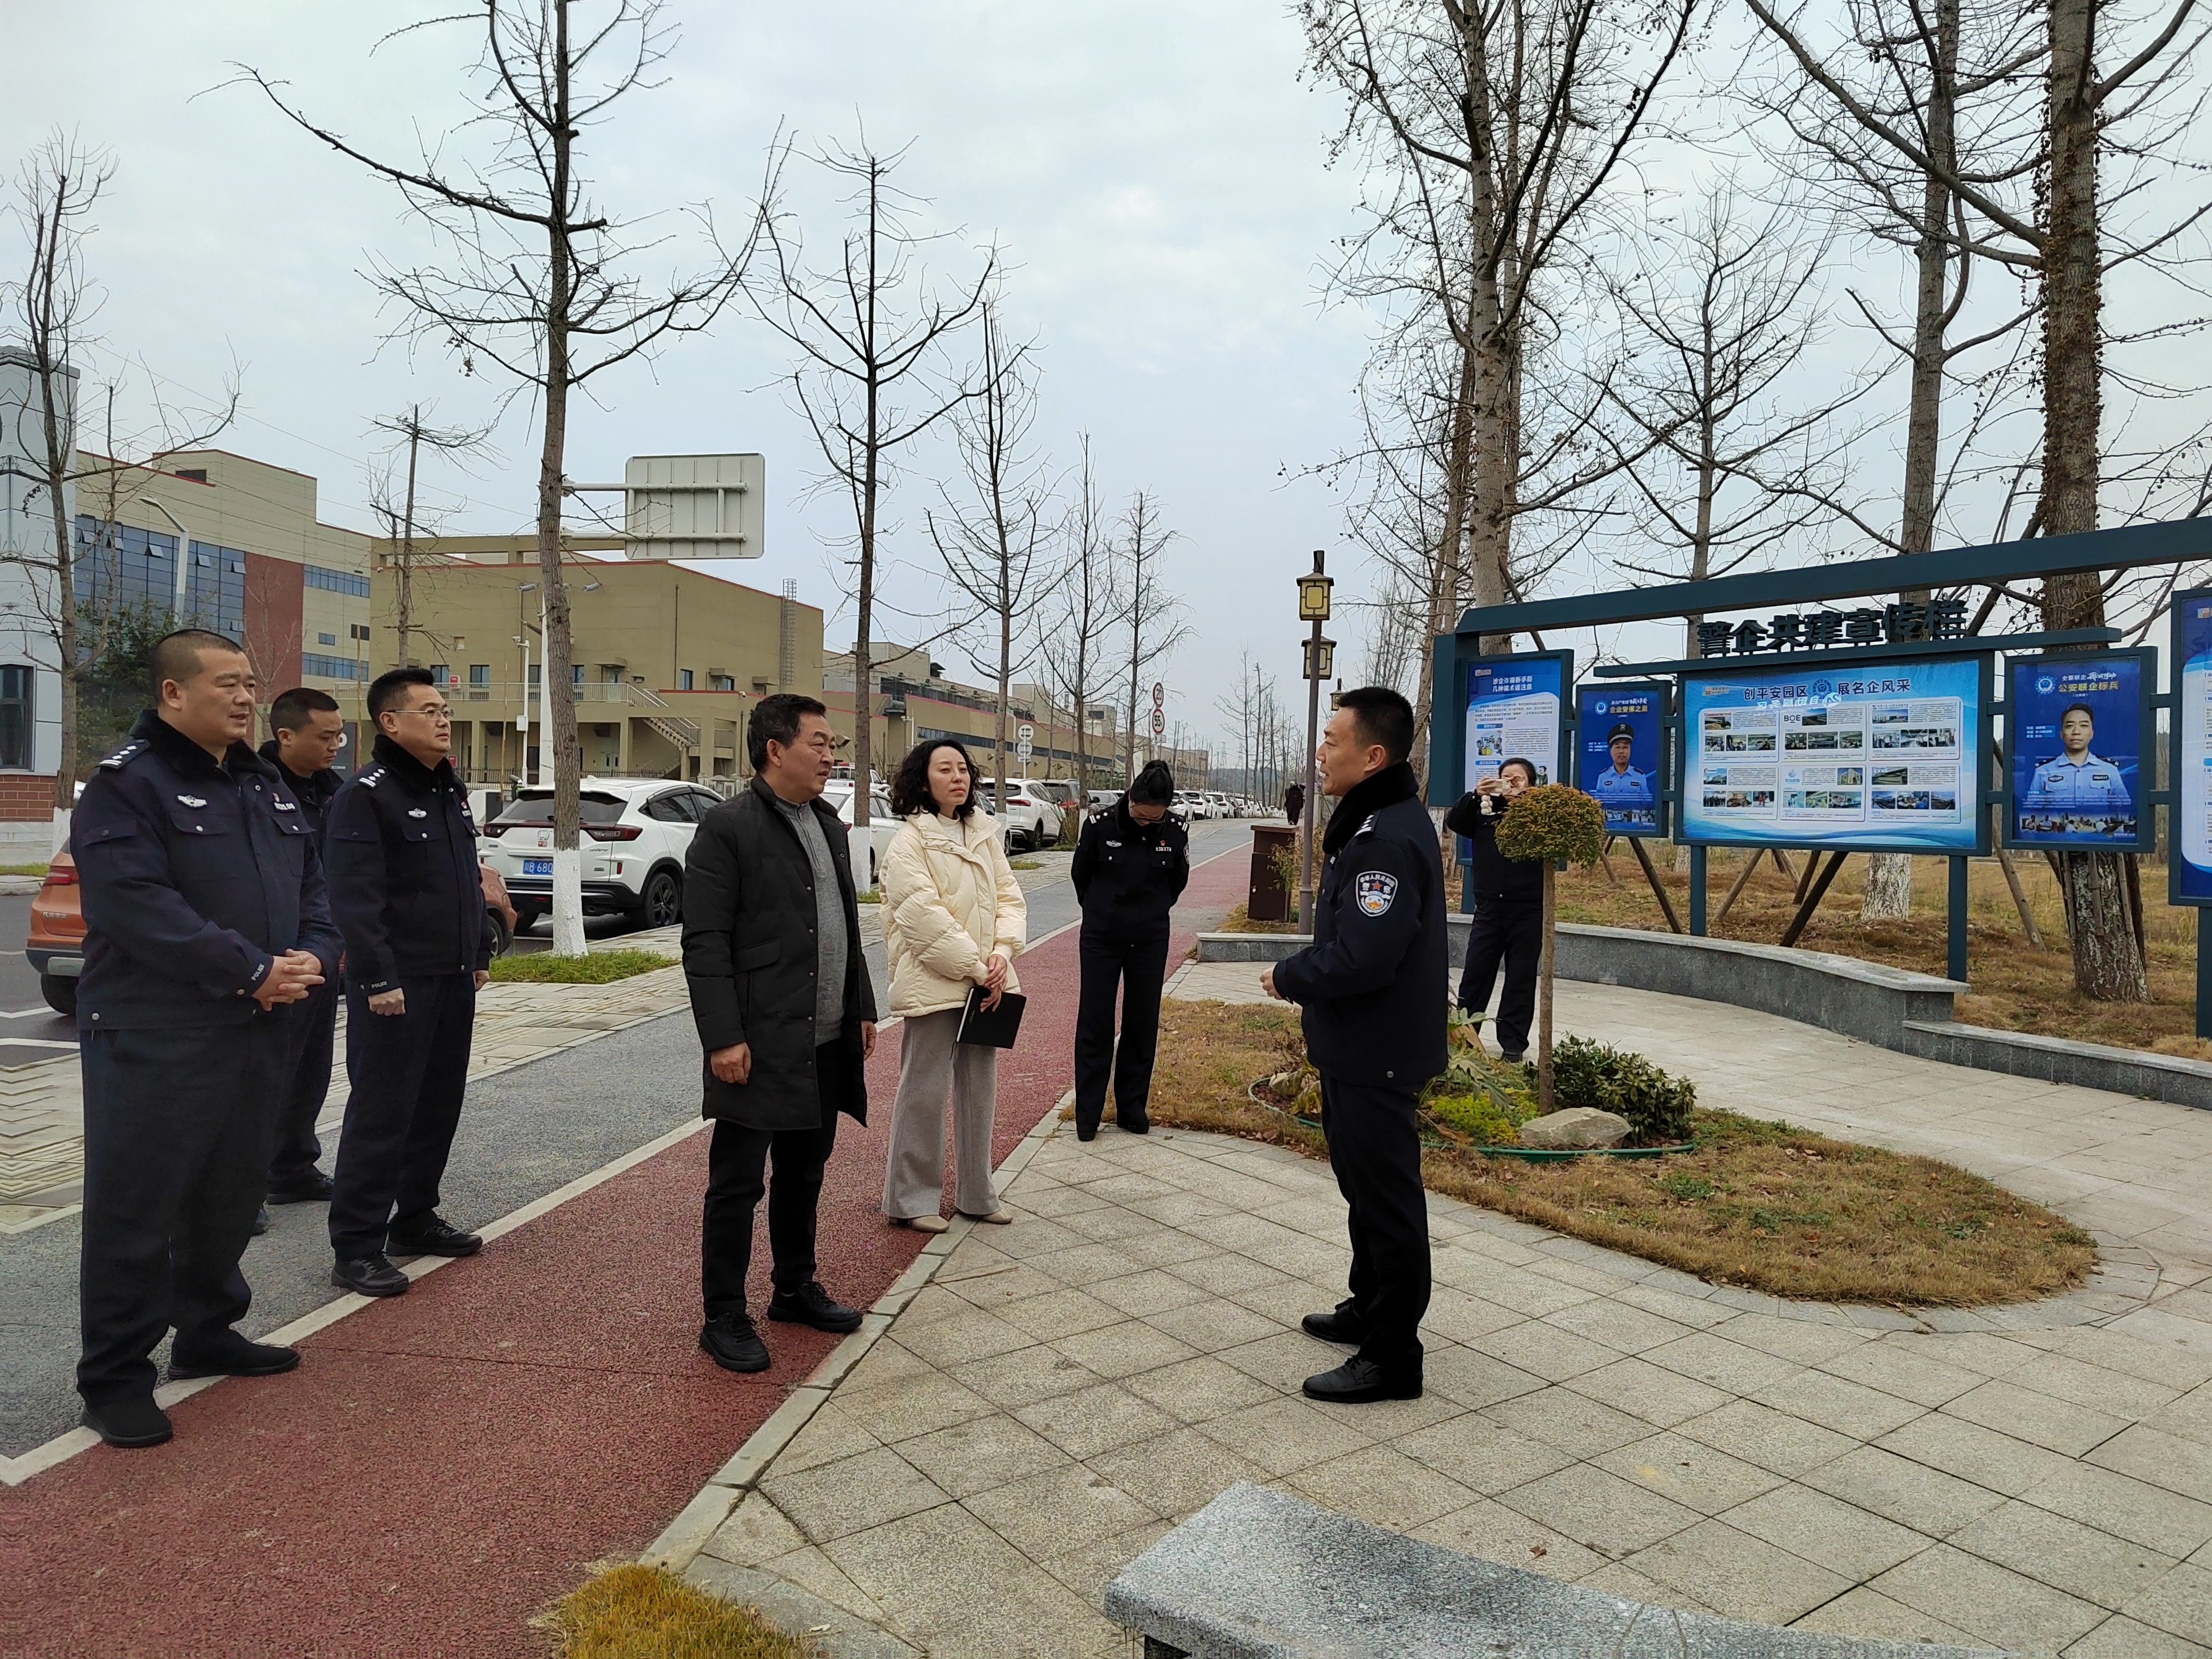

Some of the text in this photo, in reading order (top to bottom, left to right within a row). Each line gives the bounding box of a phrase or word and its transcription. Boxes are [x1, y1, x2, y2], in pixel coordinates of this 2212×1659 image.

[1698, 600, 1969, 654] 警企共建宣传栏
[1744, 685, 1808, 700] 创平安园区
[1837, 678, 1911, 695] 展名企风采
[2058, 681, 2119, 692] 公安联企标兵
[1360, 874, 1395, 887] 中华人民共和国
[251, 963, 265, 980] POLICE
